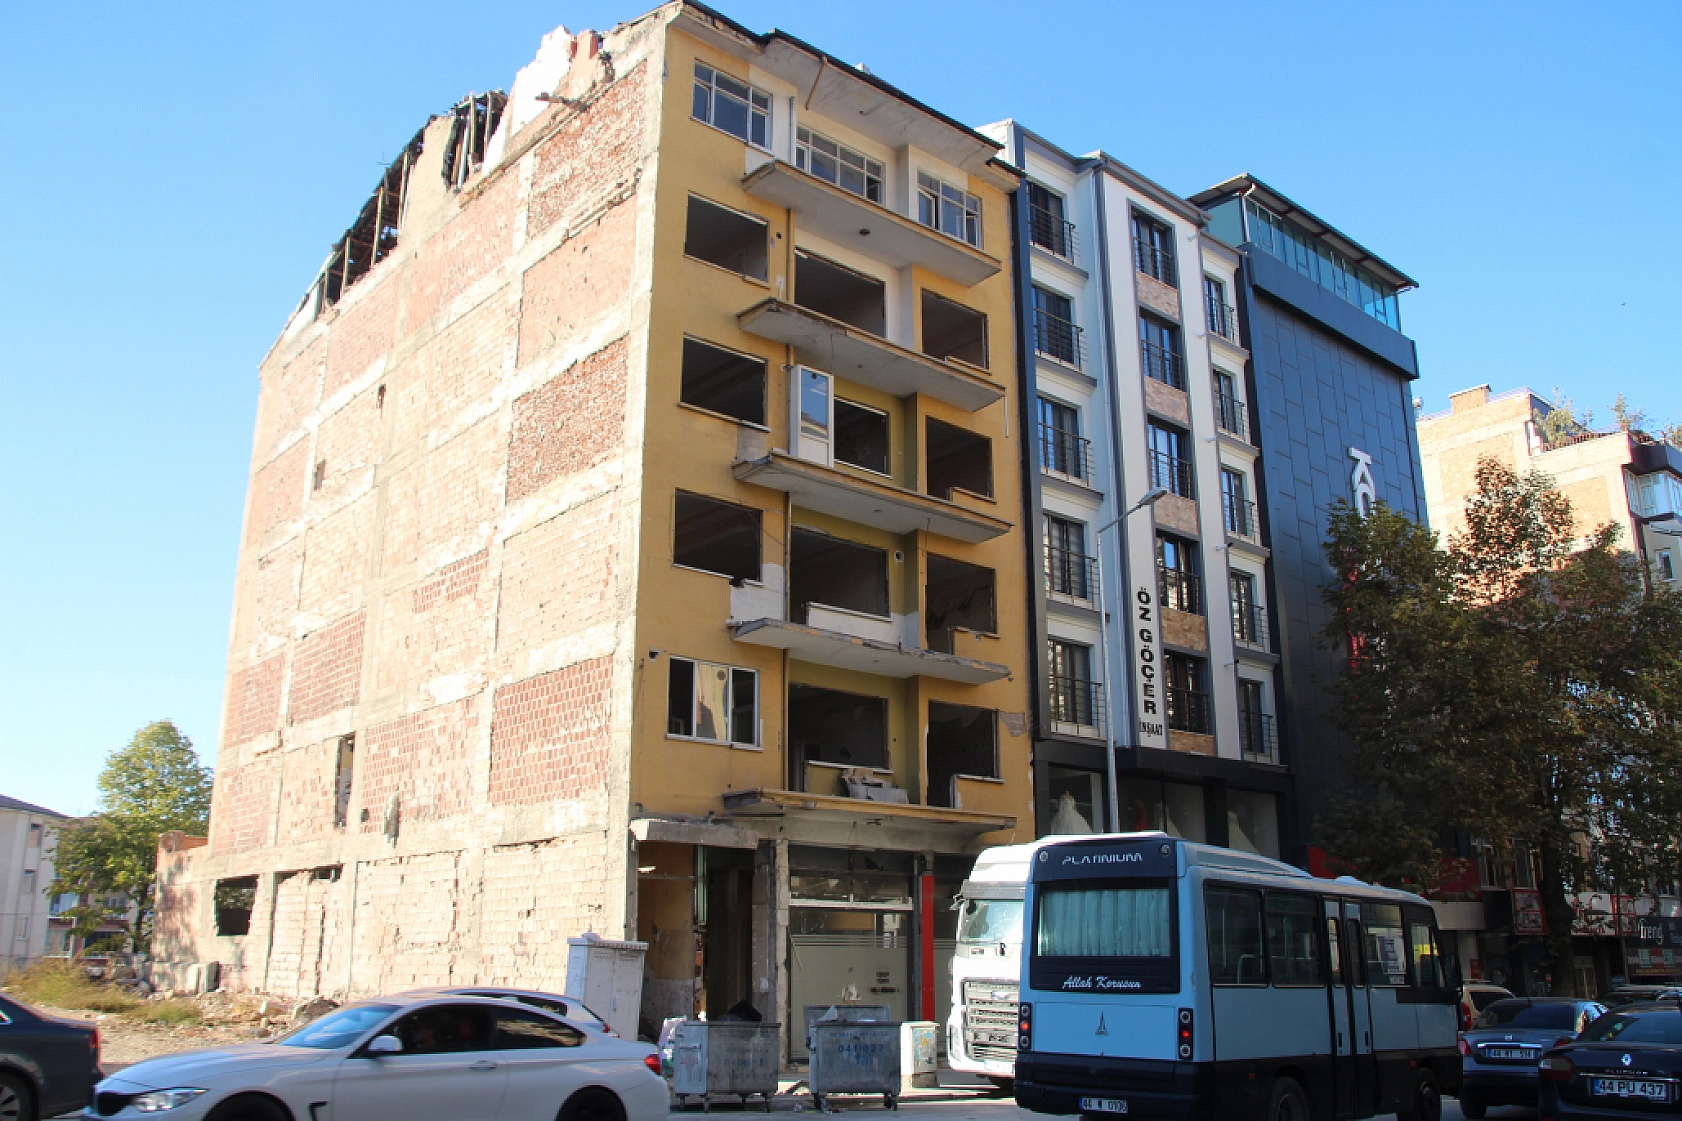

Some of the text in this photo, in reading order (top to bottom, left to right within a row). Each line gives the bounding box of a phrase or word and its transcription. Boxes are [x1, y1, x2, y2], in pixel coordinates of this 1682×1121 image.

[1062, 974, 1141, 990] Allah Korusun
[1600, 1080, 1663, 1096] 44 PU 437
